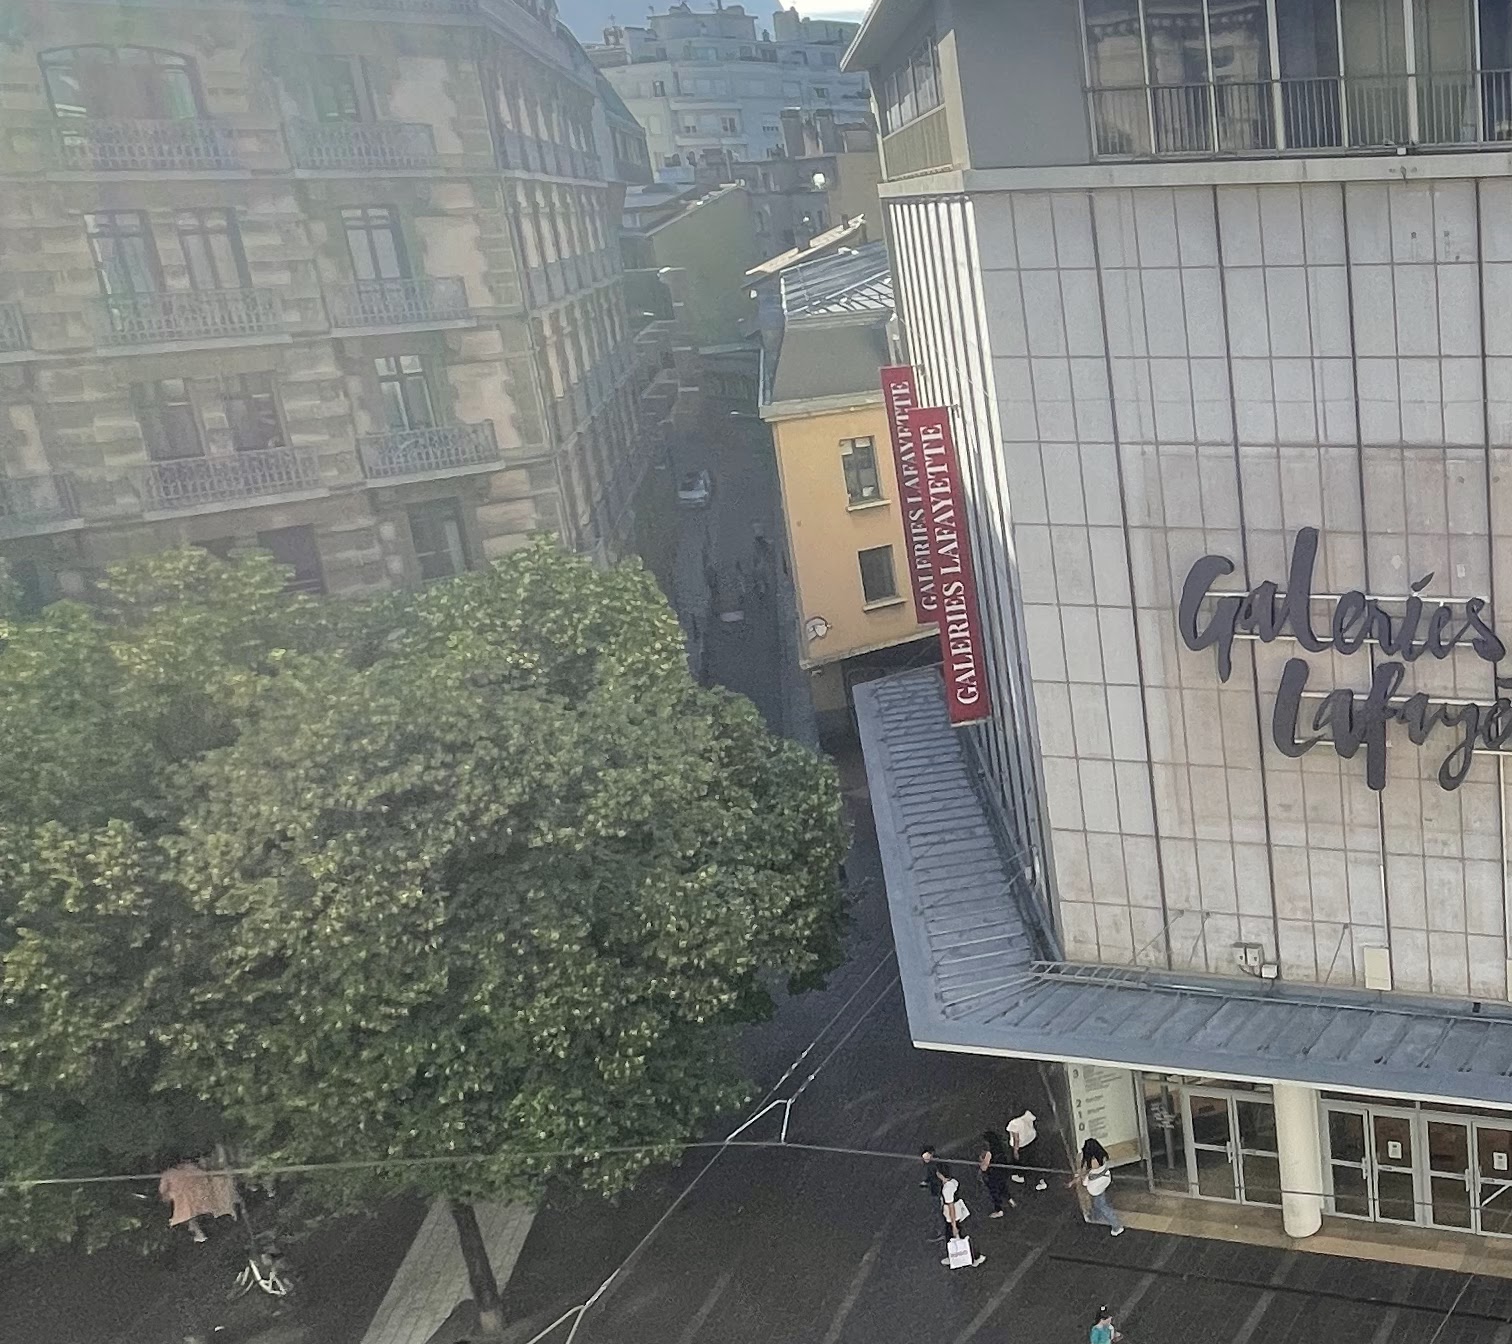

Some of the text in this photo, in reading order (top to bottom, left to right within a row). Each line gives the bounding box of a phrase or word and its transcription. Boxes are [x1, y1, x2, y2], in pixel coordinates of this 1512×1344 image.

[919, 423, 980, 705] GALERIES LAFAYETTE
[1178, 526, 1507, 683] Galeries
